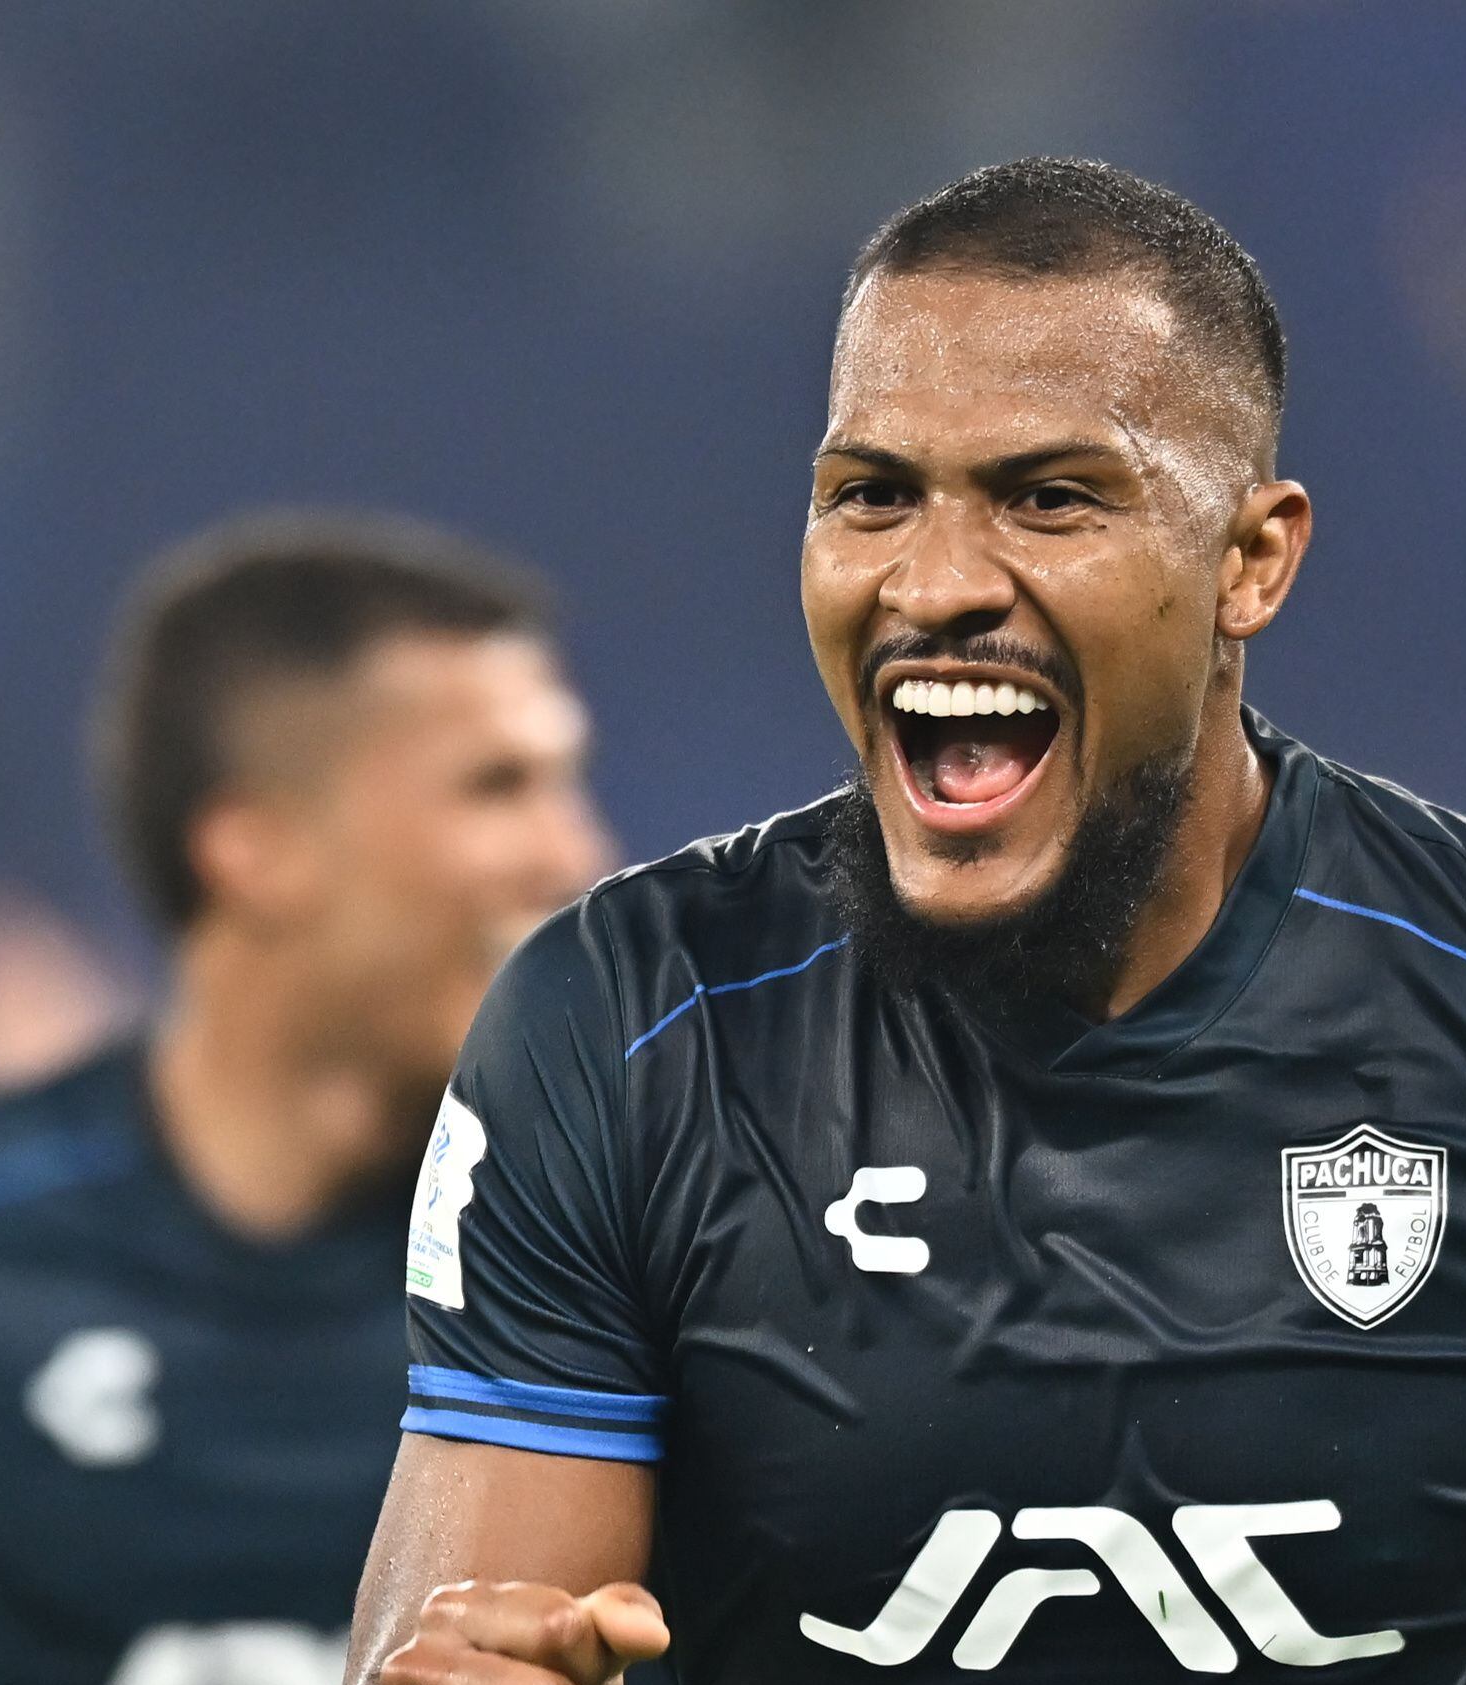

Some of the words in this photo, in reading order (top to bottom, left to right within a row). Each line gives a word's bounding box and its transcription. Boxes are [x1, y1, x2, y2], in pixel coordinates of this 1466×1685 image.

[1300, 1151, 1429, 1187] PACHUCA
[1303, 1210, 1325, 1257] CLUB
[1316, 1260, 1340, 1284] DE
[1395, 1209, 1427, 1278] FUTBOL
[799, 1499, 1405, 1673] JAC
